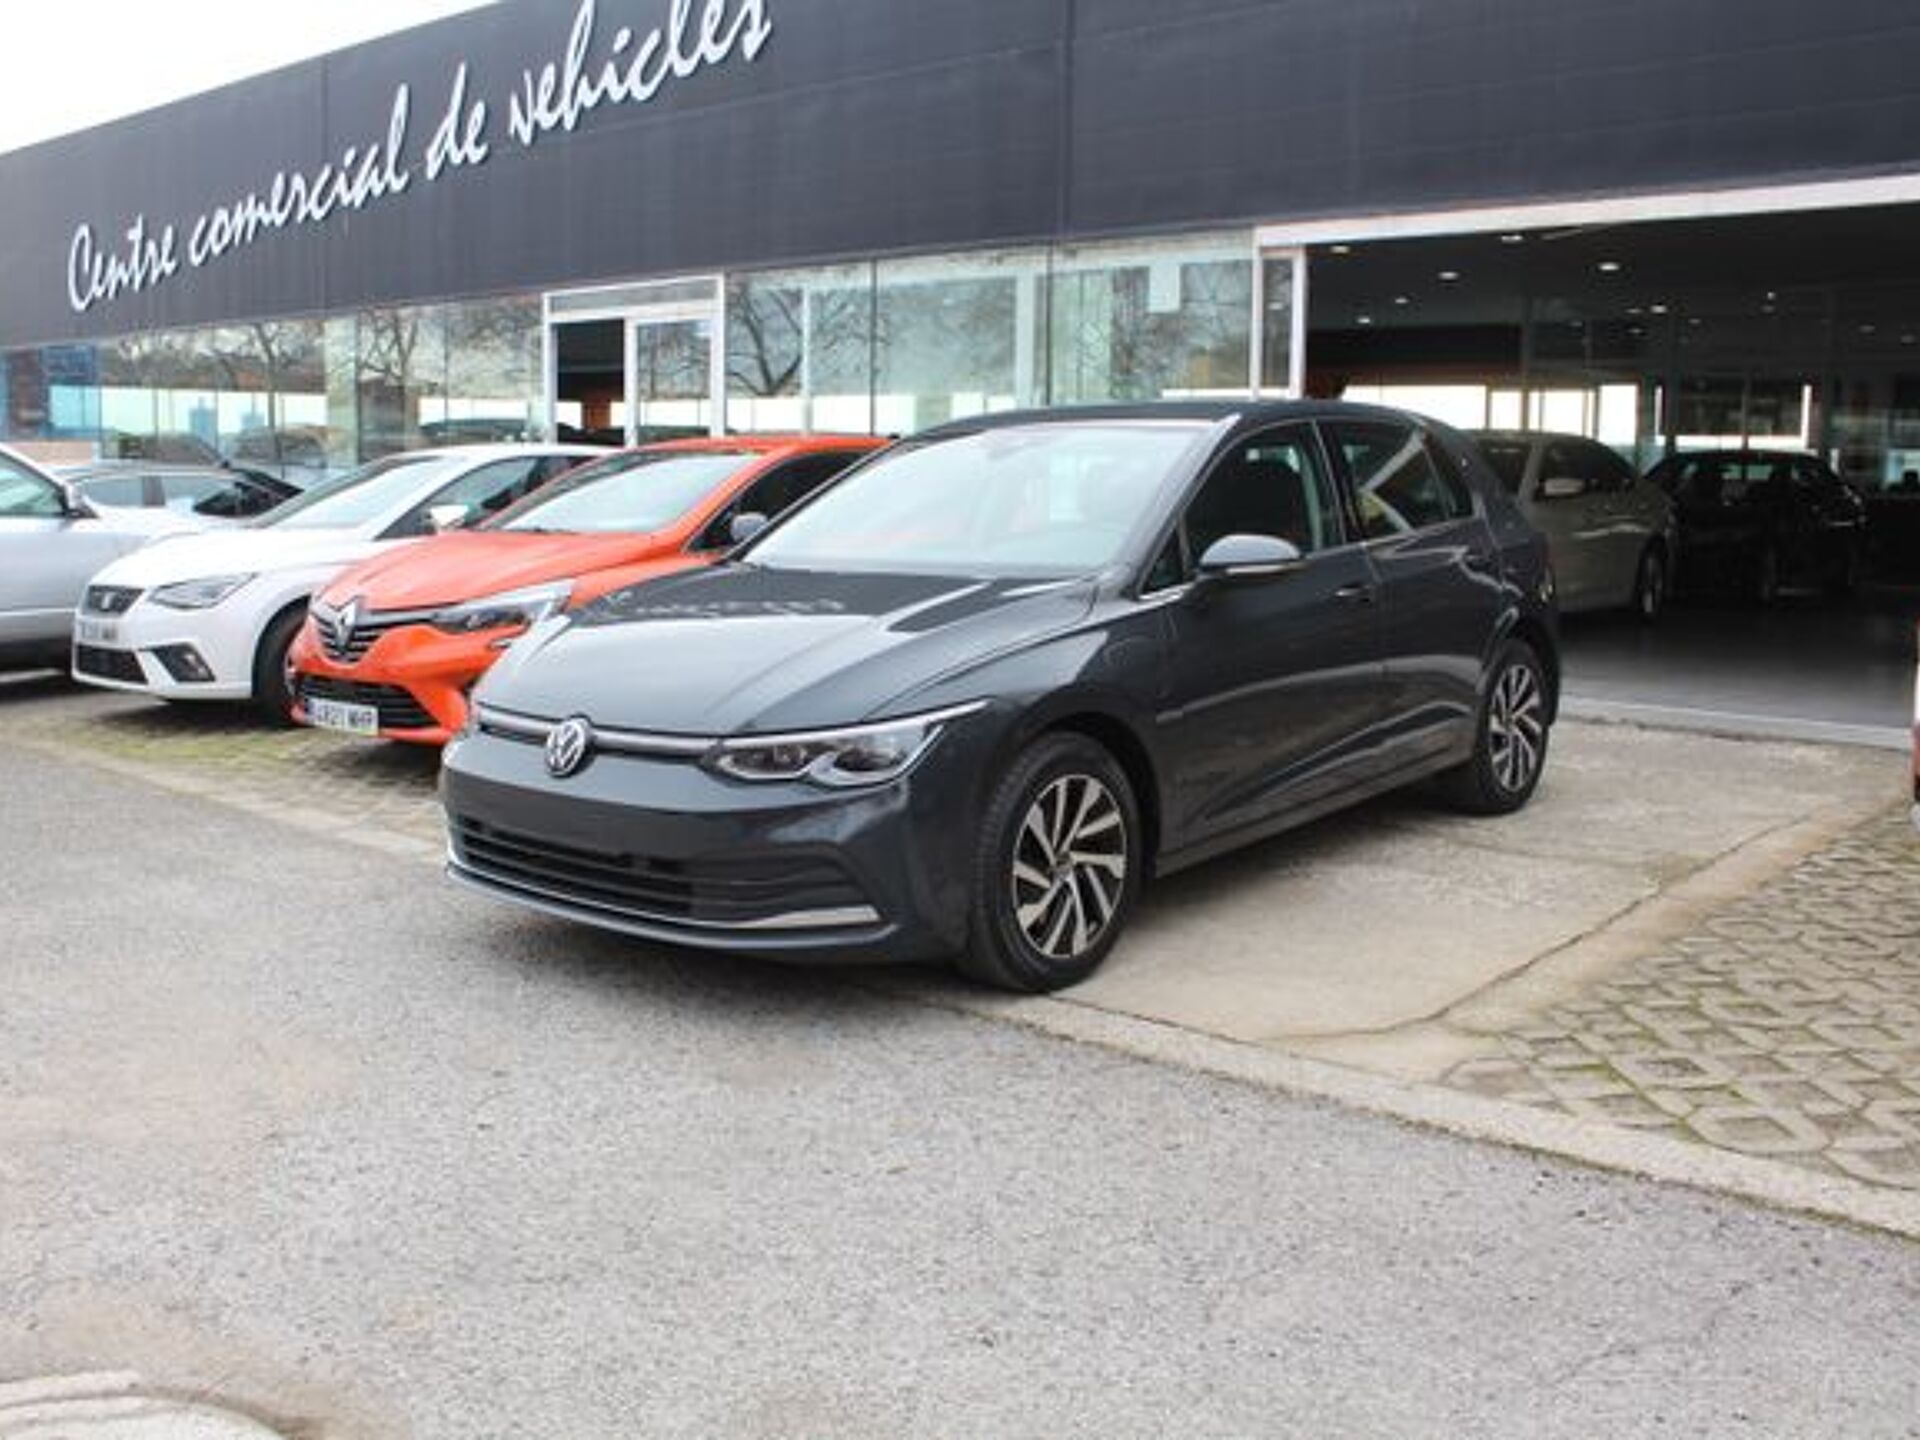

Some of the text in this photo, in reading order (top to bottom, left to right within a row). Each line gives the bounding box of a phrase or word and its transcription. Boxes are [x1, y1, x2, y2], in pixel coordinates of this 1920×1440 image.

[68, 0, 772, 311] Centre comercial de vehicles
